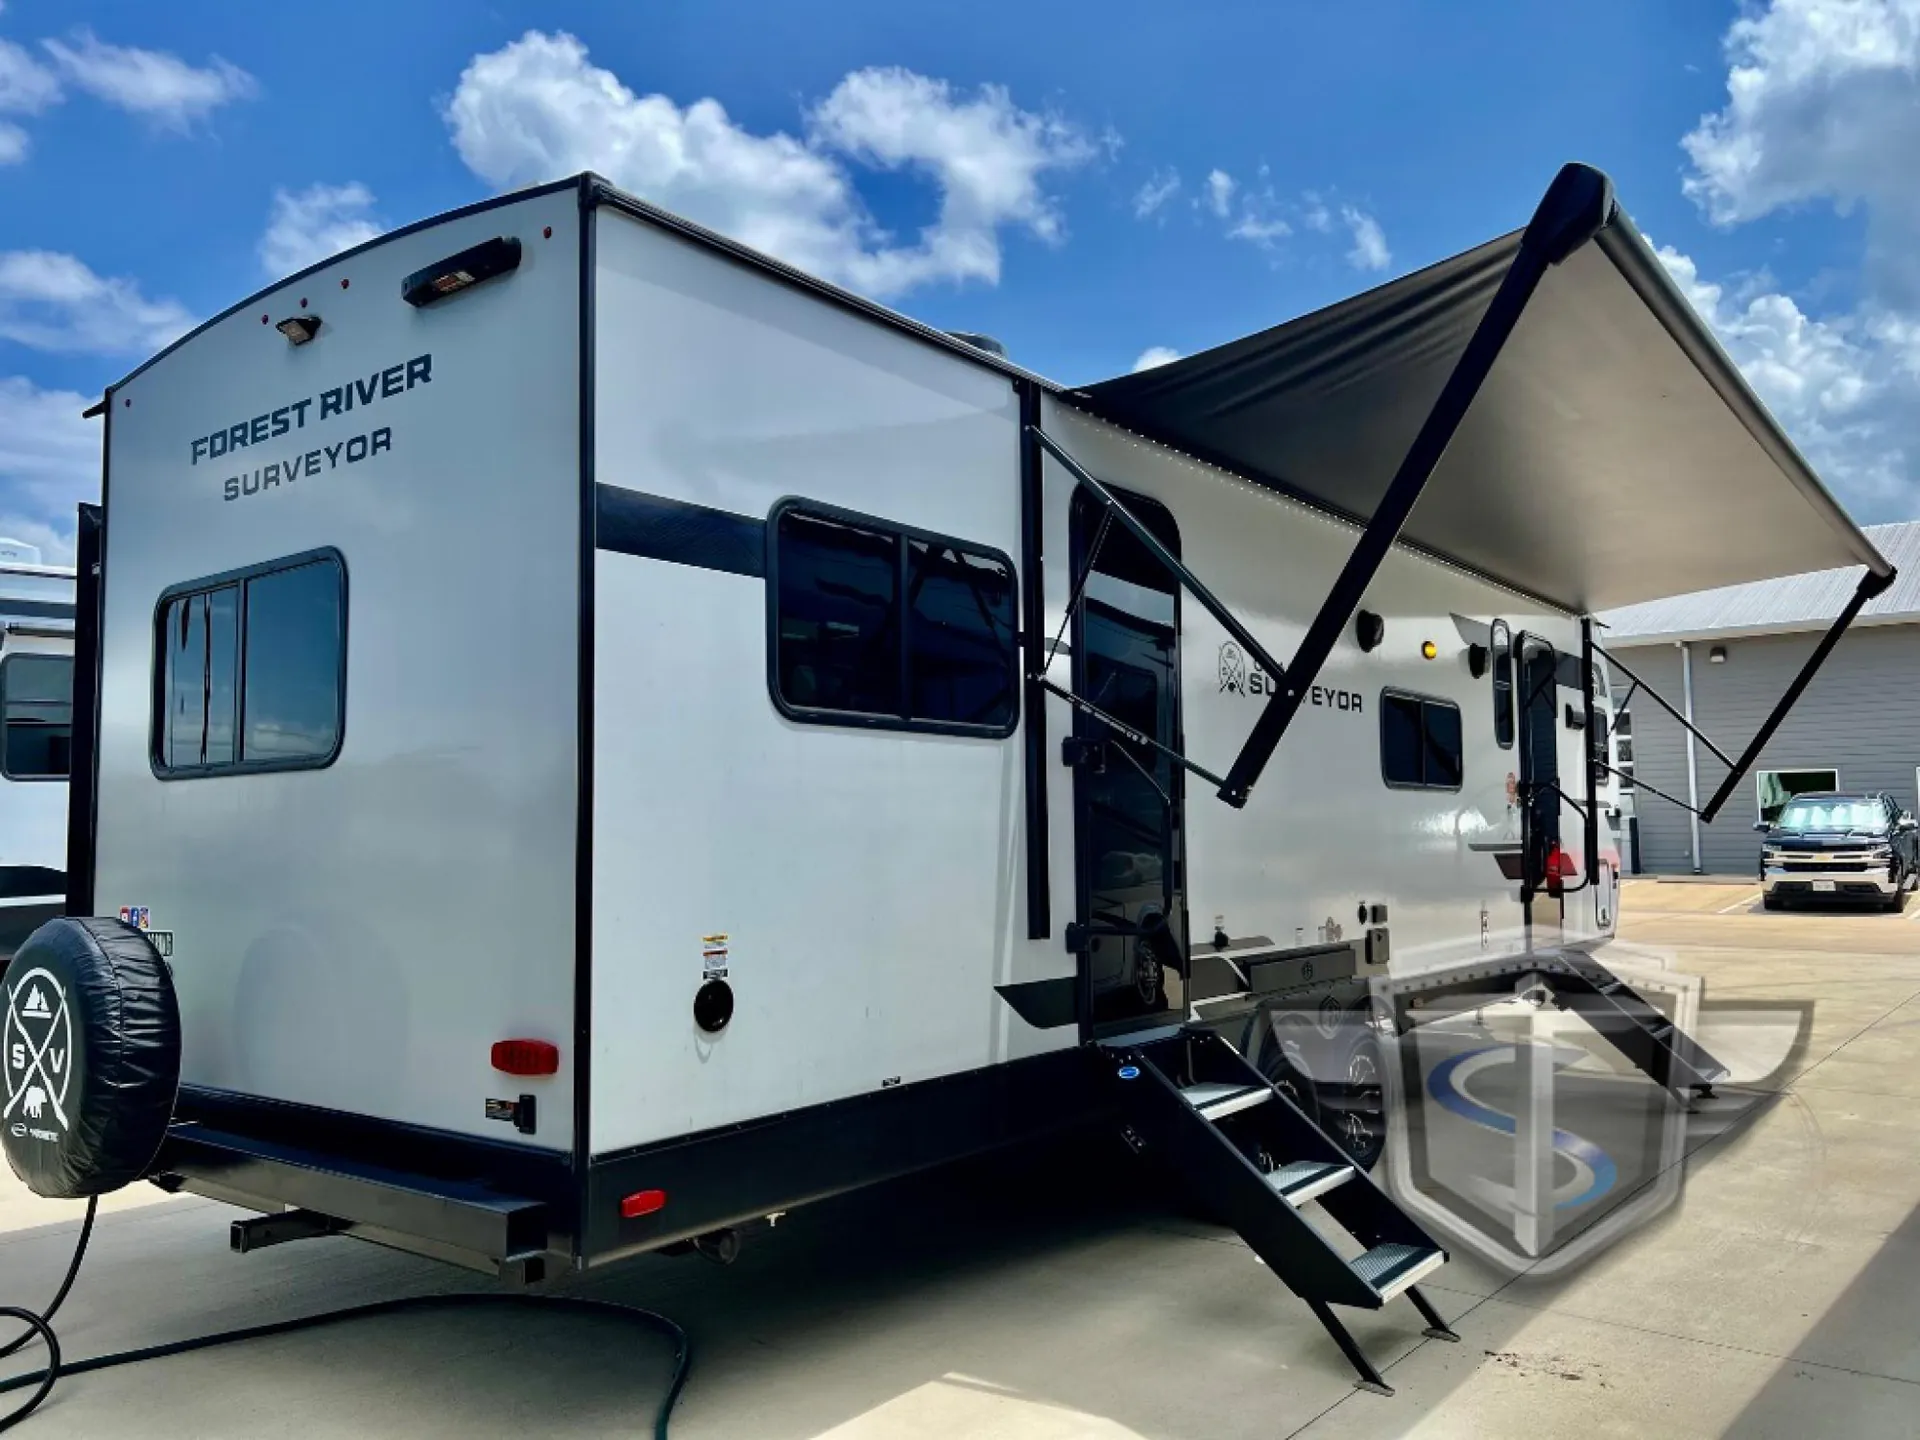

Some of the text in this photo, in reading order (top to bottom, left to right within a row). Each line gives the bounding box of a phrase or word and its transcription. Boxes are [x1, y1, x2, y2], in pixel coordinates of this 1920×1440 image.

[190, 353, 432, 465] FOREST RIVER
[223, 426, 392, 501] SURVEYOR
[1249, 672, 1363, 713] SUEYOR
[12, 1043, 65, 1074] S V
